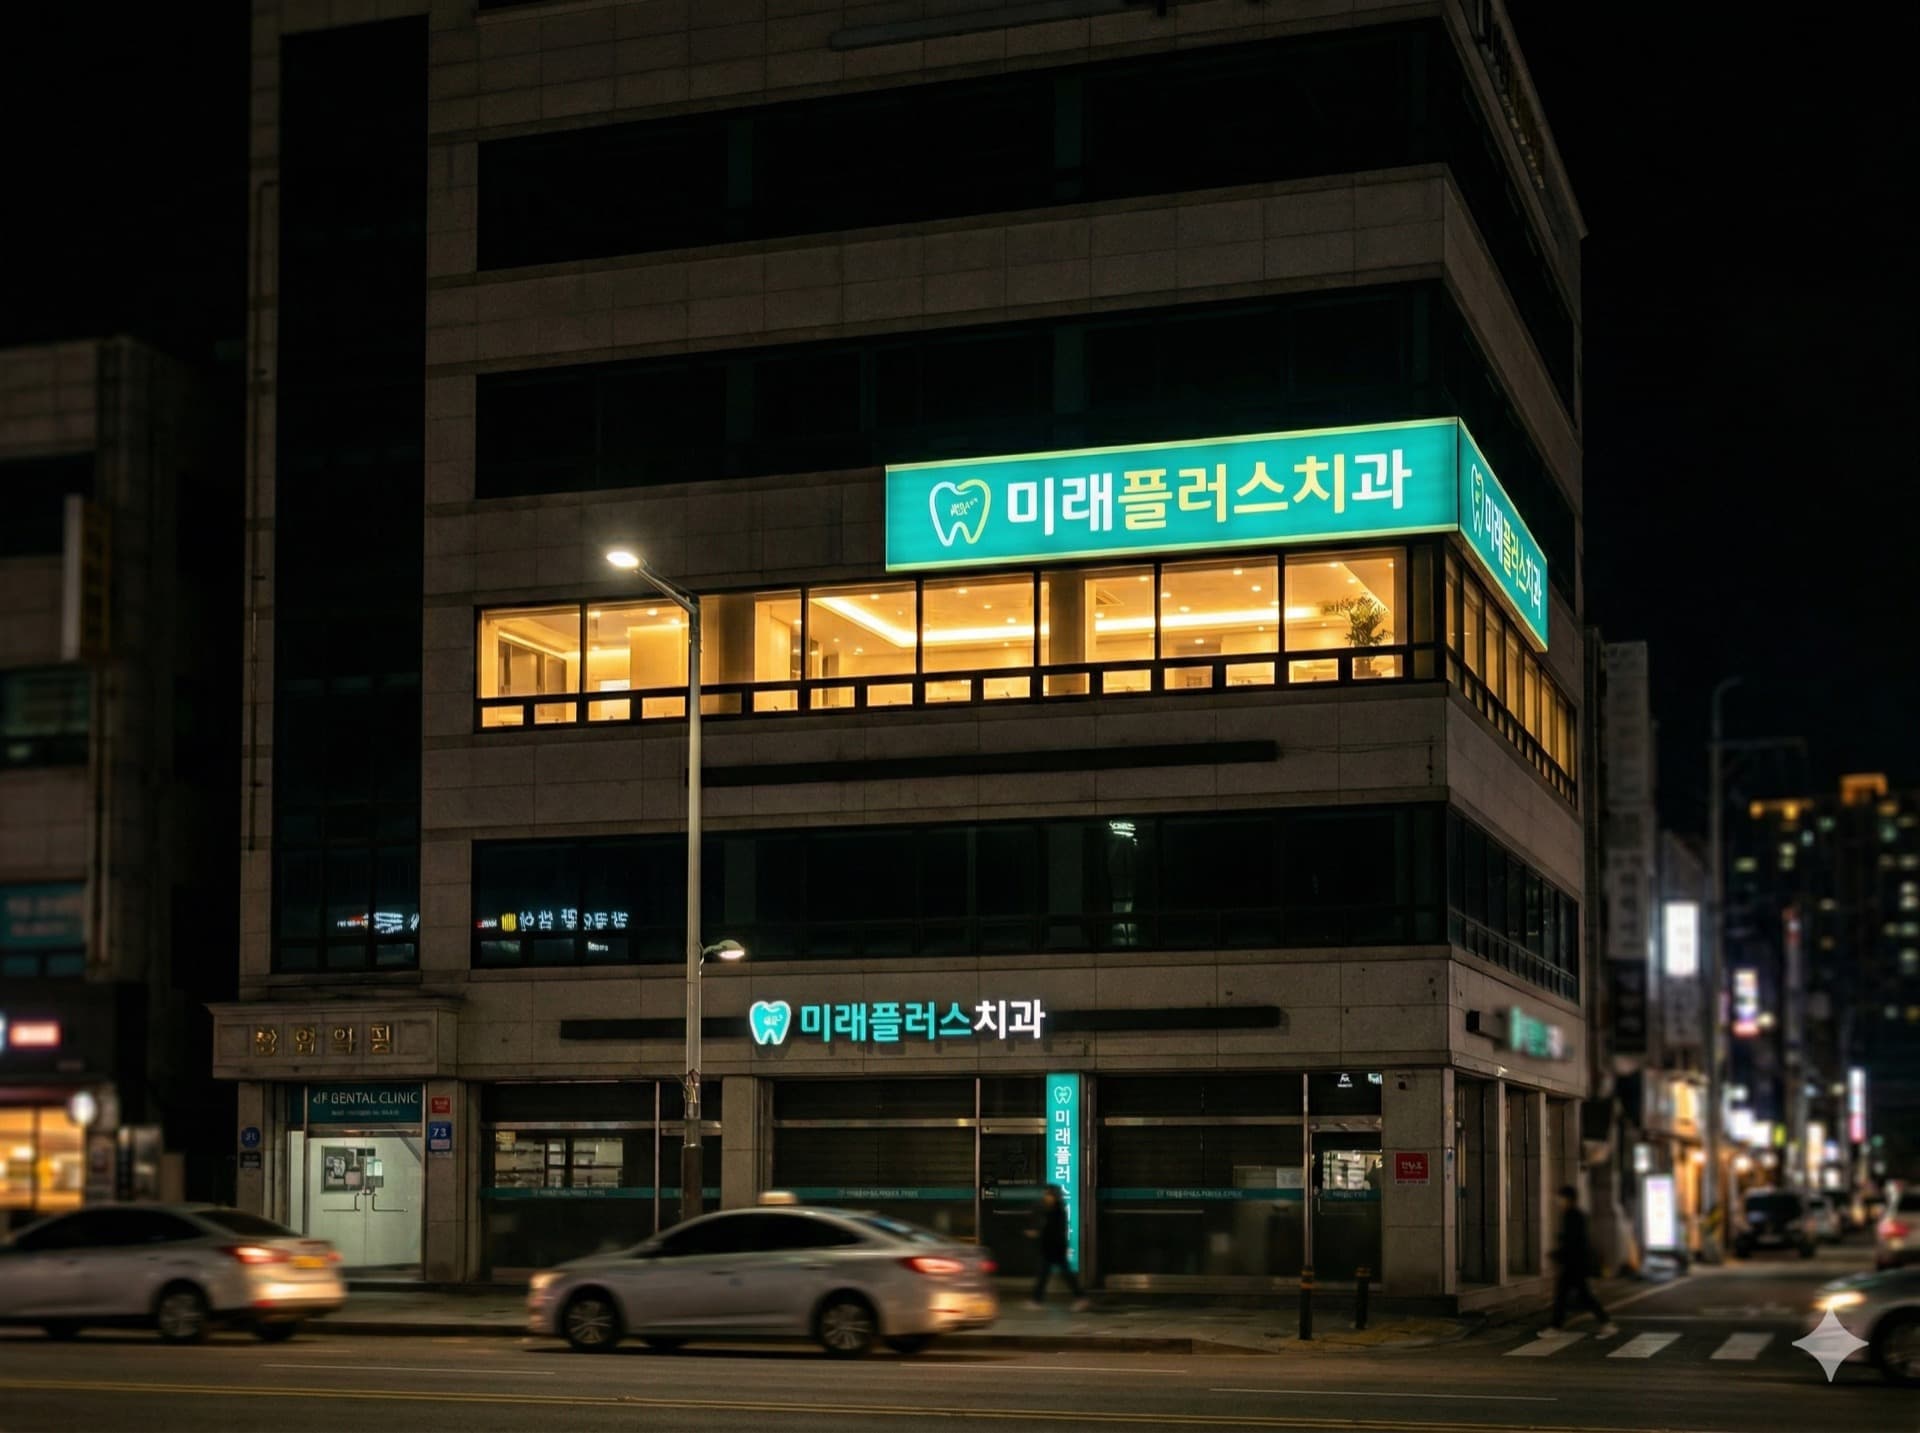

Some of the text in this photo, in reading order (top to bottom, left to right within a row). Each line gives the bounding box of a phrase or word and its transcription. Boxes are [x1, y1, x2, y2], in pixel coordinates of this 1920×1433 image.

[1007, 447, 1412, 537] 미래플러스치과
[1485, 494, 1542, 619] 미래플러스치과
[800, 998, 1047, 1043] 미래플러스치과
[379, 1091, 419, 1105] CLINIC
[432, 1127, 448, 1138] 73
